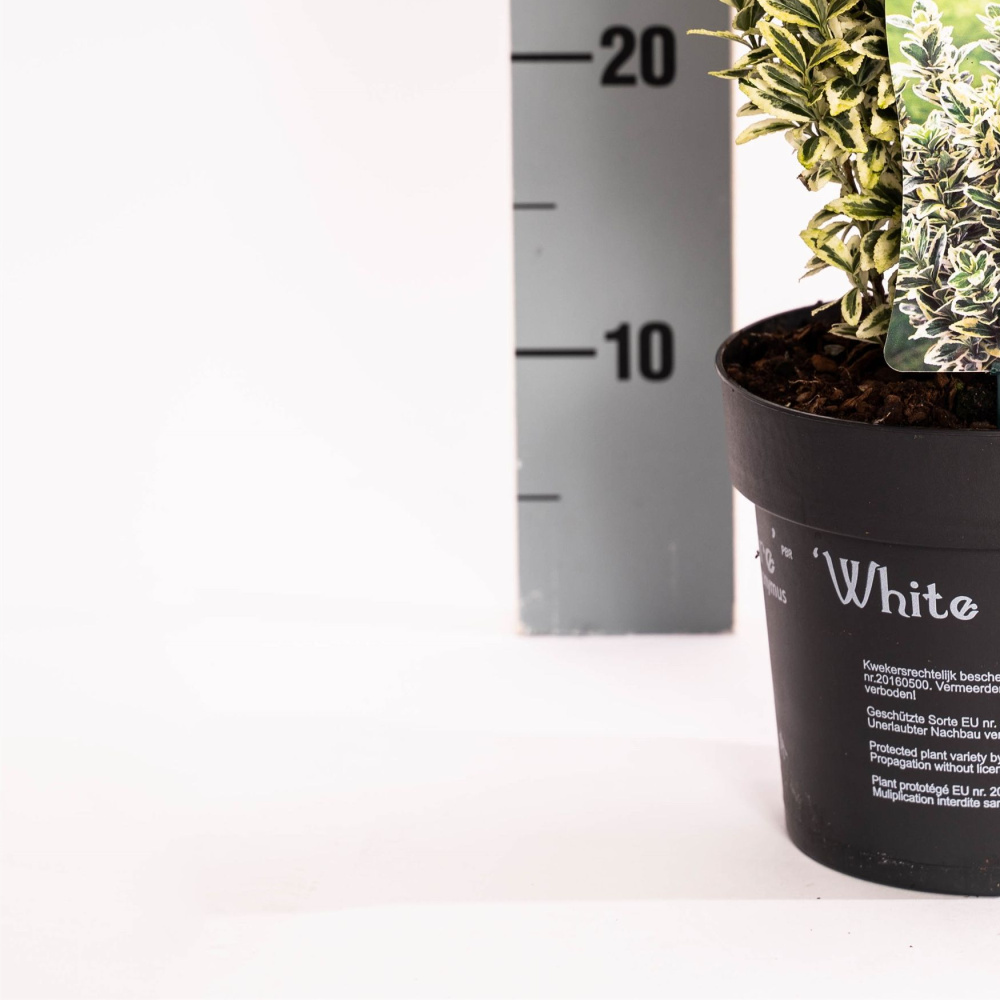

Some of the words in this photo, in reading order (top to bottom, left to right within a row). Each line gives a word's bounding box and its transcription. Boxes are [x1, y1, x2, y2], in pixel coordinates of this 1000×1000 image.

[600, 24, 677, 88] 20
[605, 322, 674, 382] 10
[863, 660, 956, 681] Kwekersrechtelijk
[864, 673, 932, 691] nr.20160500.
[865, 685, 917, 700] verboden!
[867, 706, 925, 723] Geschützte
[929, 715, 958, 727] Sorte
[962, 717, 979, 727] EU
[983, 719, 997, 728] nr.
[868, 718, 927, 736] Unerlaubter
[931, 727, 980, 739] Nachbau
[870, 741, 917, 757] Protected
[921, 748, 947, 761] plant
[950, 751, 986, 764] variety
[870, 752, 931, 770] Propagation
[934, 762, 974, 773] without
[872, 775, 896, 789] Plant
[899, 780, 949, 797] prototégé
[952, 785, 969, 796] EU
[973, 787, 986, 797] nr.
[872, 787, 934, 805] Muliplication
[937, 795, 980, 807] interdite
